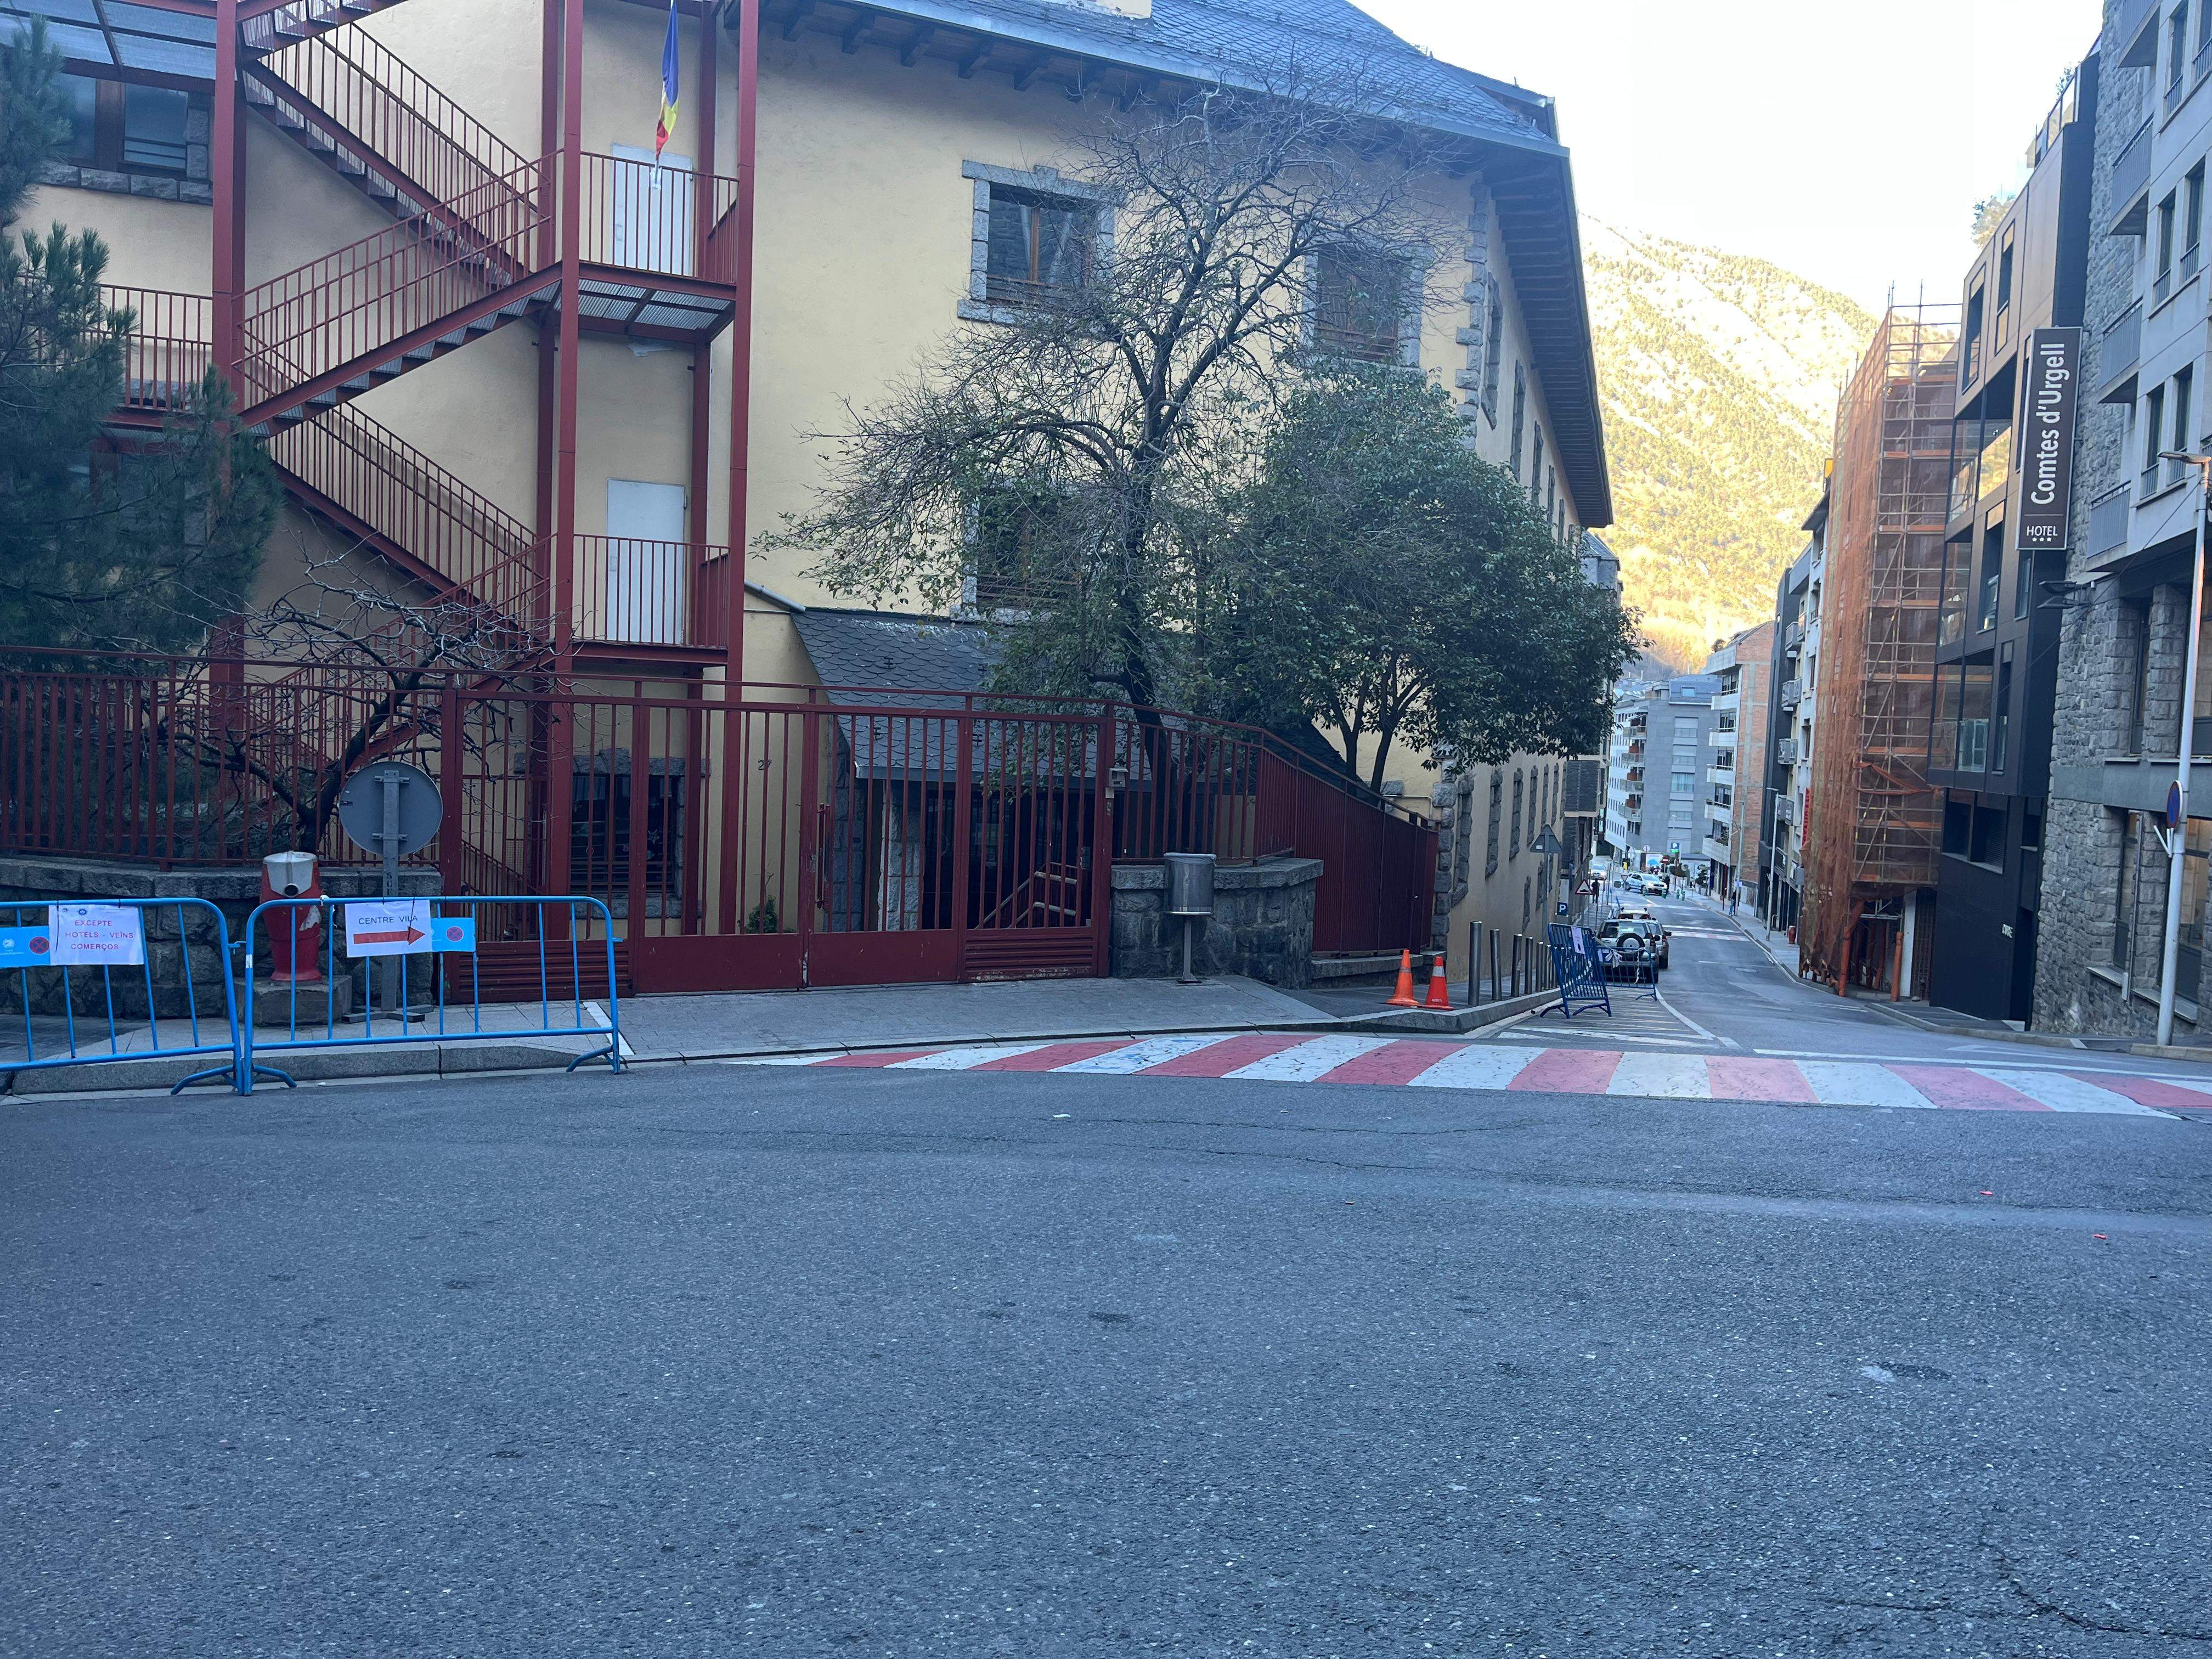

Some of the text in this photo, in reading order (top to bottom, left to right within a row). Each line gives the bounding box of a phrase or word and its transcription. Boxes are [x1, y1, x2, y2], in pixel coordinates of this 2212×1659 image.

[2030, 343, 2070, 505] Comtes d'Urgell
[2026, 525, 2058, 537] HOTEL
[1559, 904, 1566, 912] P
[358, 916, 394, 925] CENTRE
